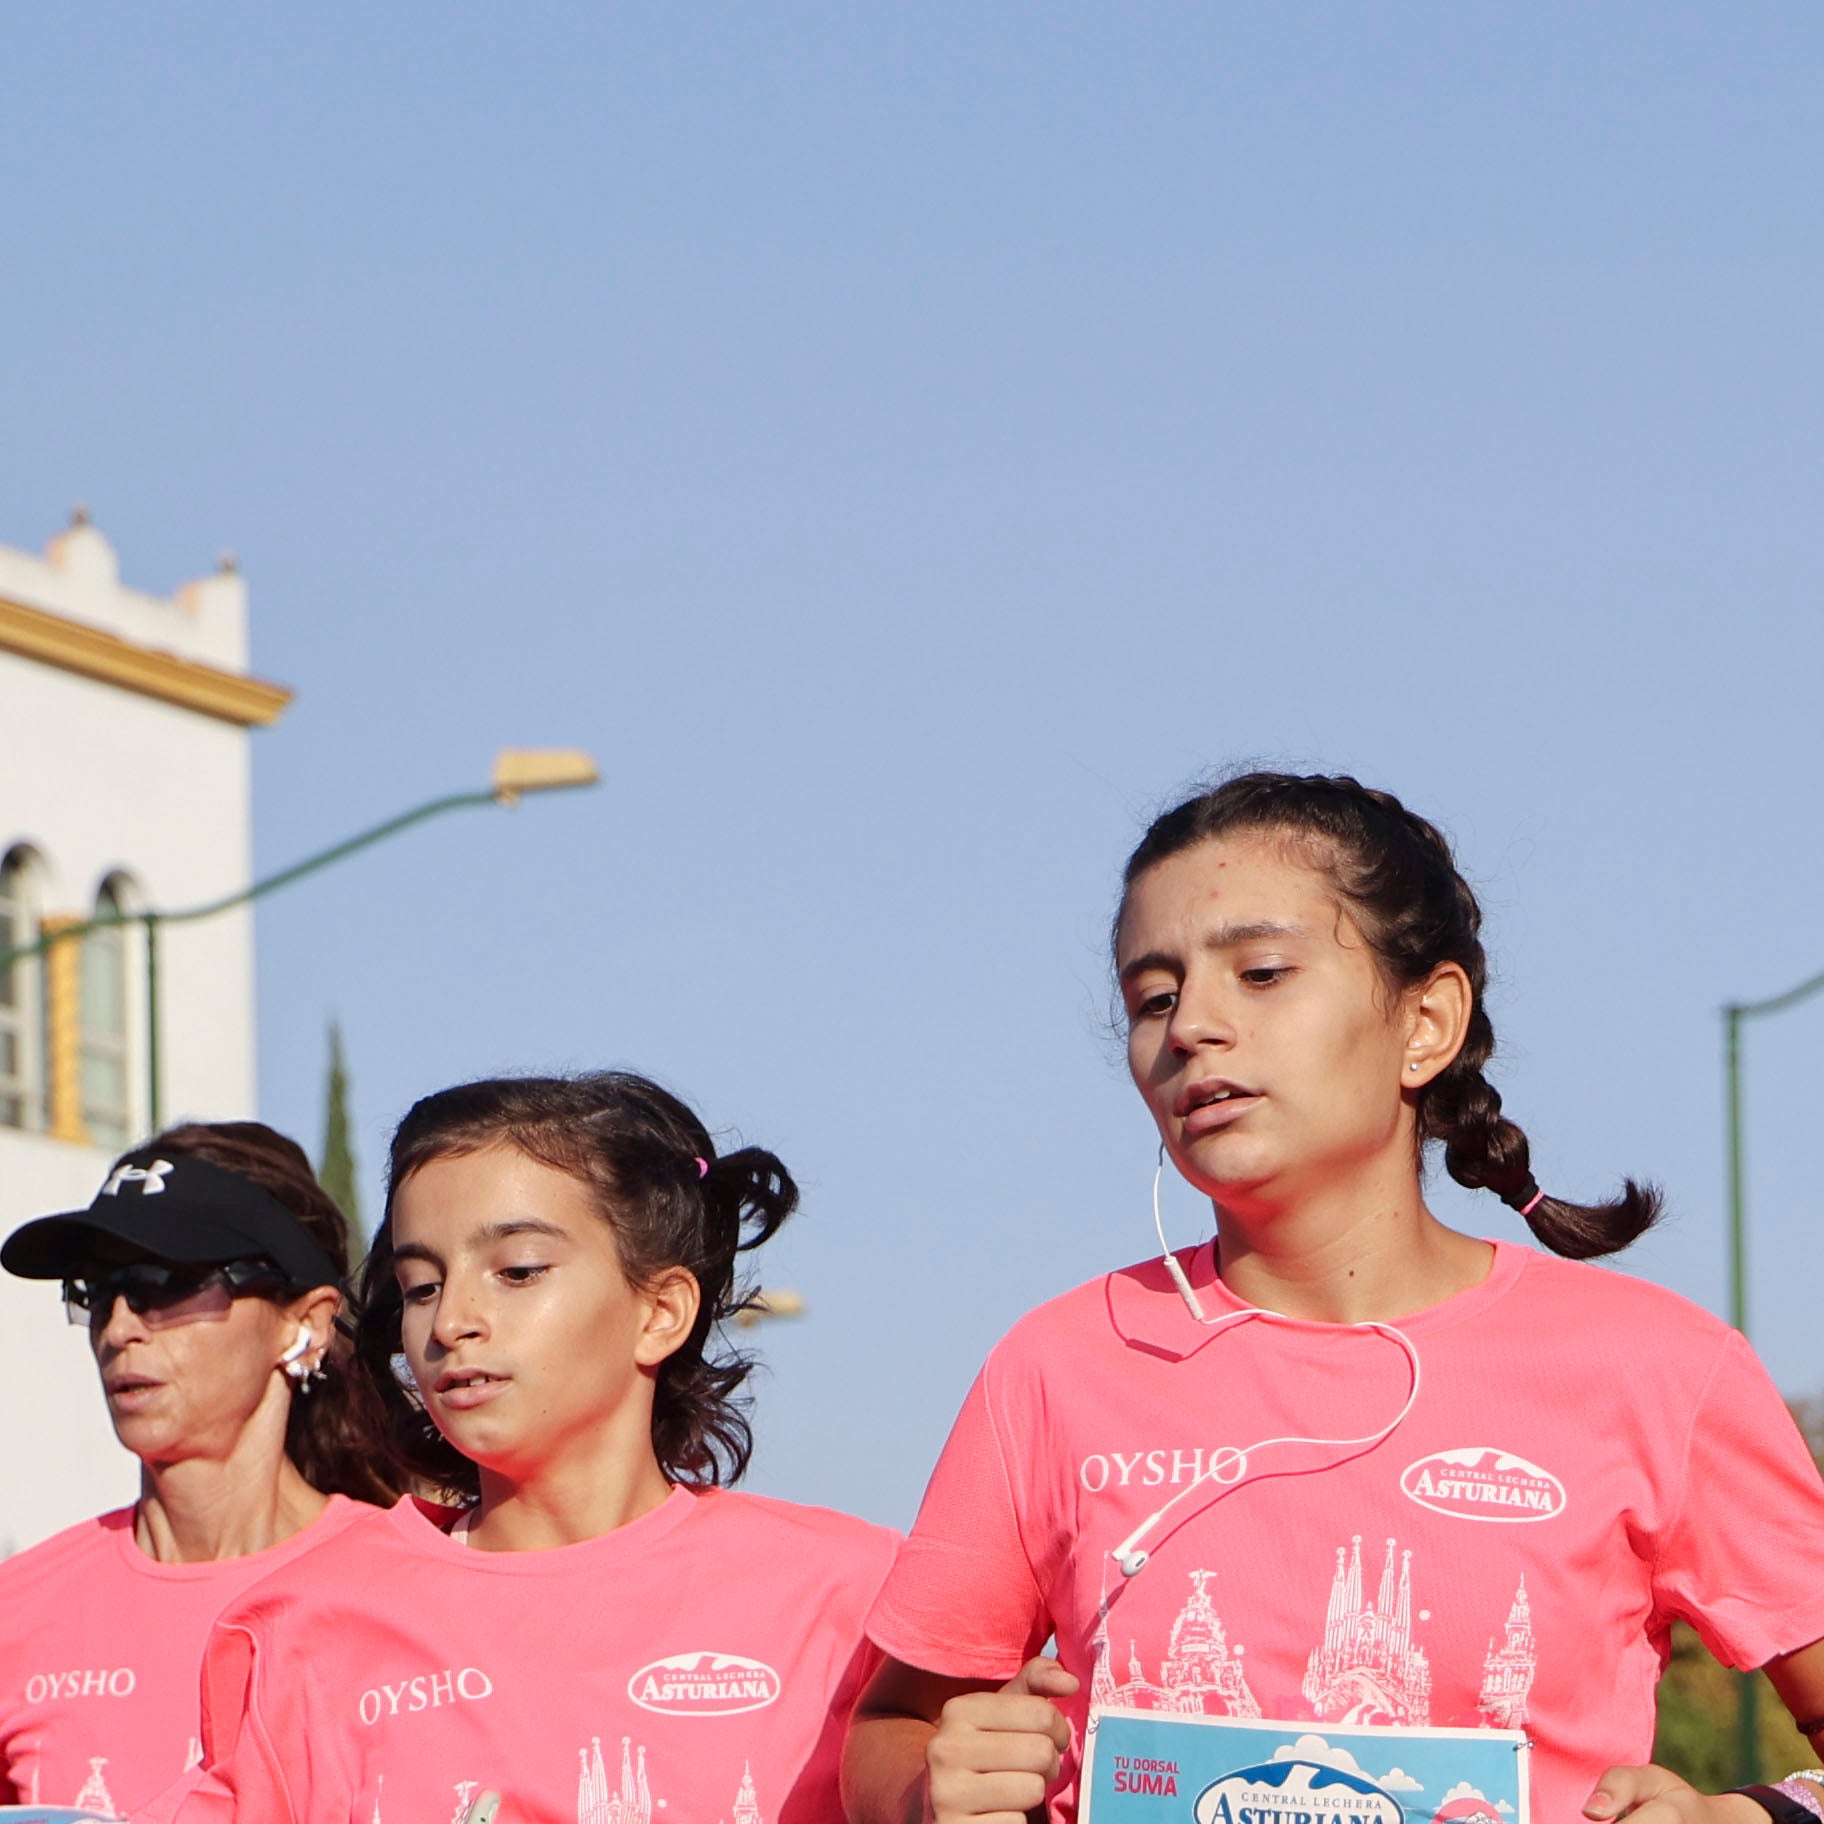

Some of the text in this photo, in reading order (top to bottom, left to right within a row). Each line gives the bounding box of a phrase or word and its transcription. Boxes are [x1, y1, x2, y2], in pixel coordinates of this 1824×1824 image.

[1080, 1447, 1247, 1492] OYSHO
[1440, 1468, 1551, 1488] CENTRAL LECHERA
[1413, 1469, 1553, 1511] ASTURIANA
[26, 1667, 136, 1704] OYSHO
[640, 1675, 770, 1700] ASTURIANA
[664, 1673, 712, 1681] CENTRAL
[360, 1668, 493, 1726] OYSHO
[1114, 1756, 1179, 1774] TU DORSAL
[1114, 1771, 1177, 1797] SUMA
[1241, 1792, 1382, 1809] CENTRAL LECHERA
